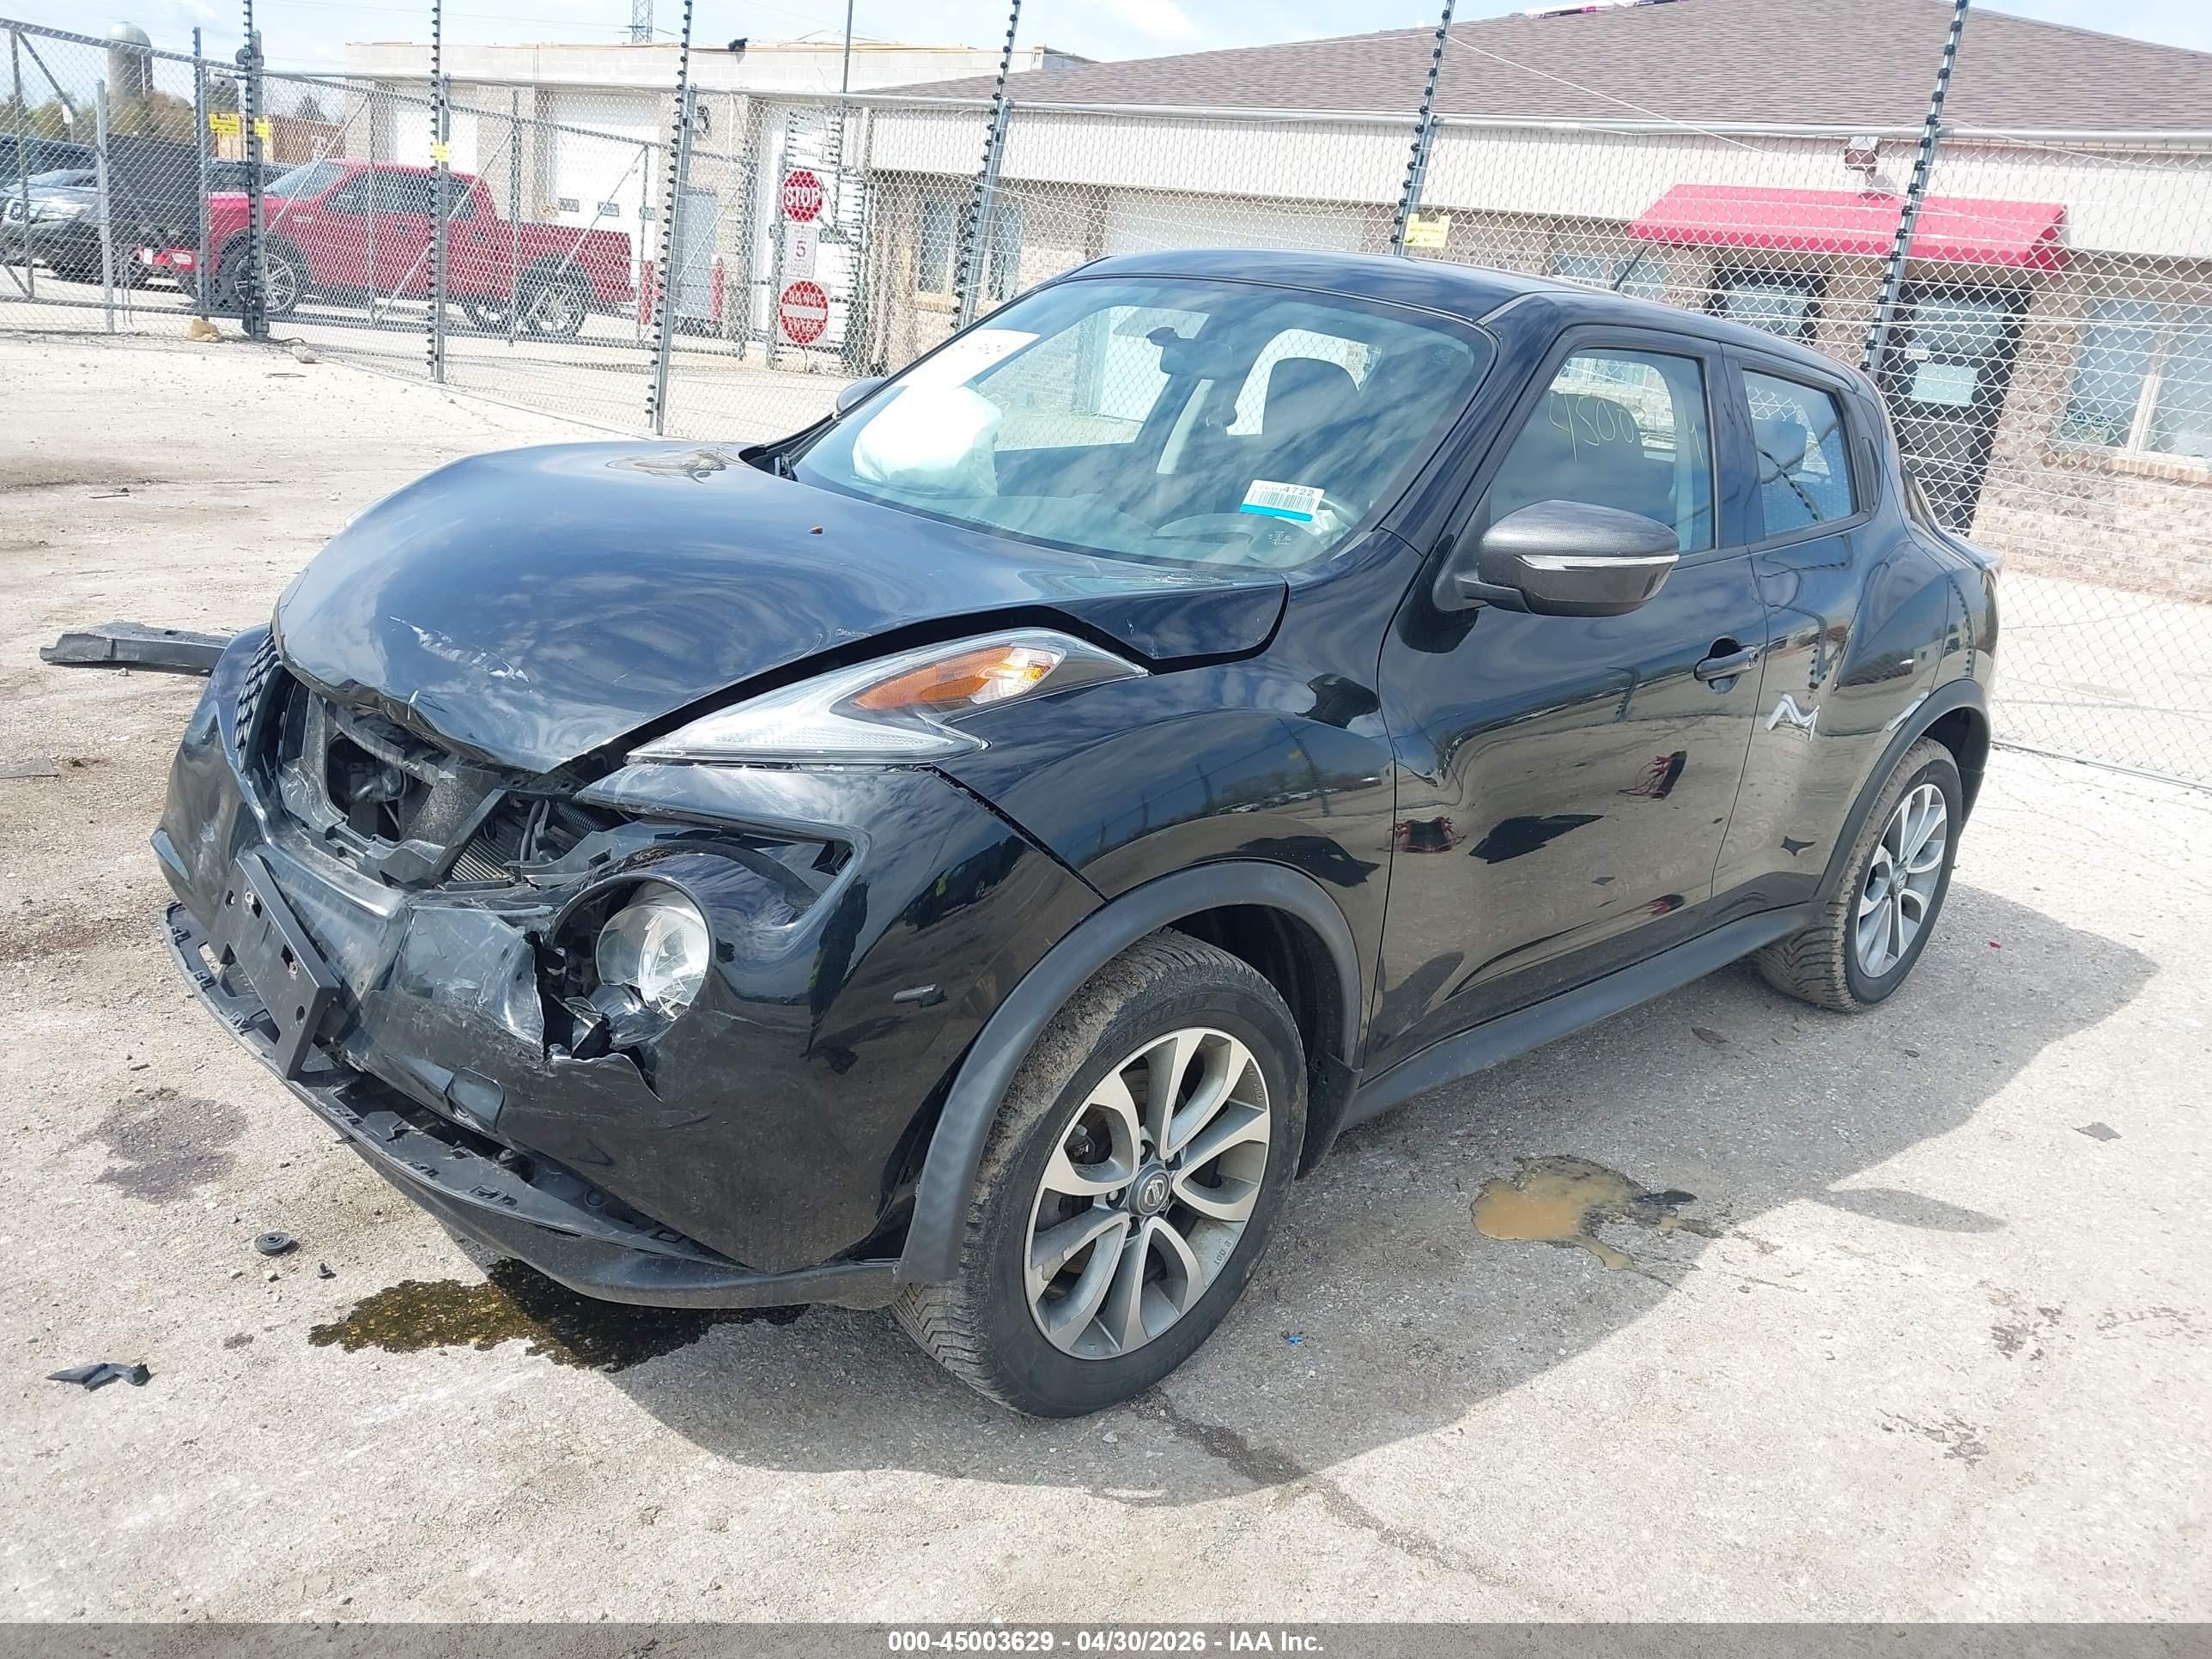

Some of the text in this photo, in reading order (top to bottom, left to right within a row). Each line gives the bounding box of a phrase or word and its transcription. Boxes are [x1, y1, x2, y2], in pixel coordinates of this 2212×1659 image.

[785, 188, 821, 206] STOP
[796, 240, 806, 258] 5
[788, 292, 823, 307] DO NOT
[787, 319, 818, 334] ENTER
